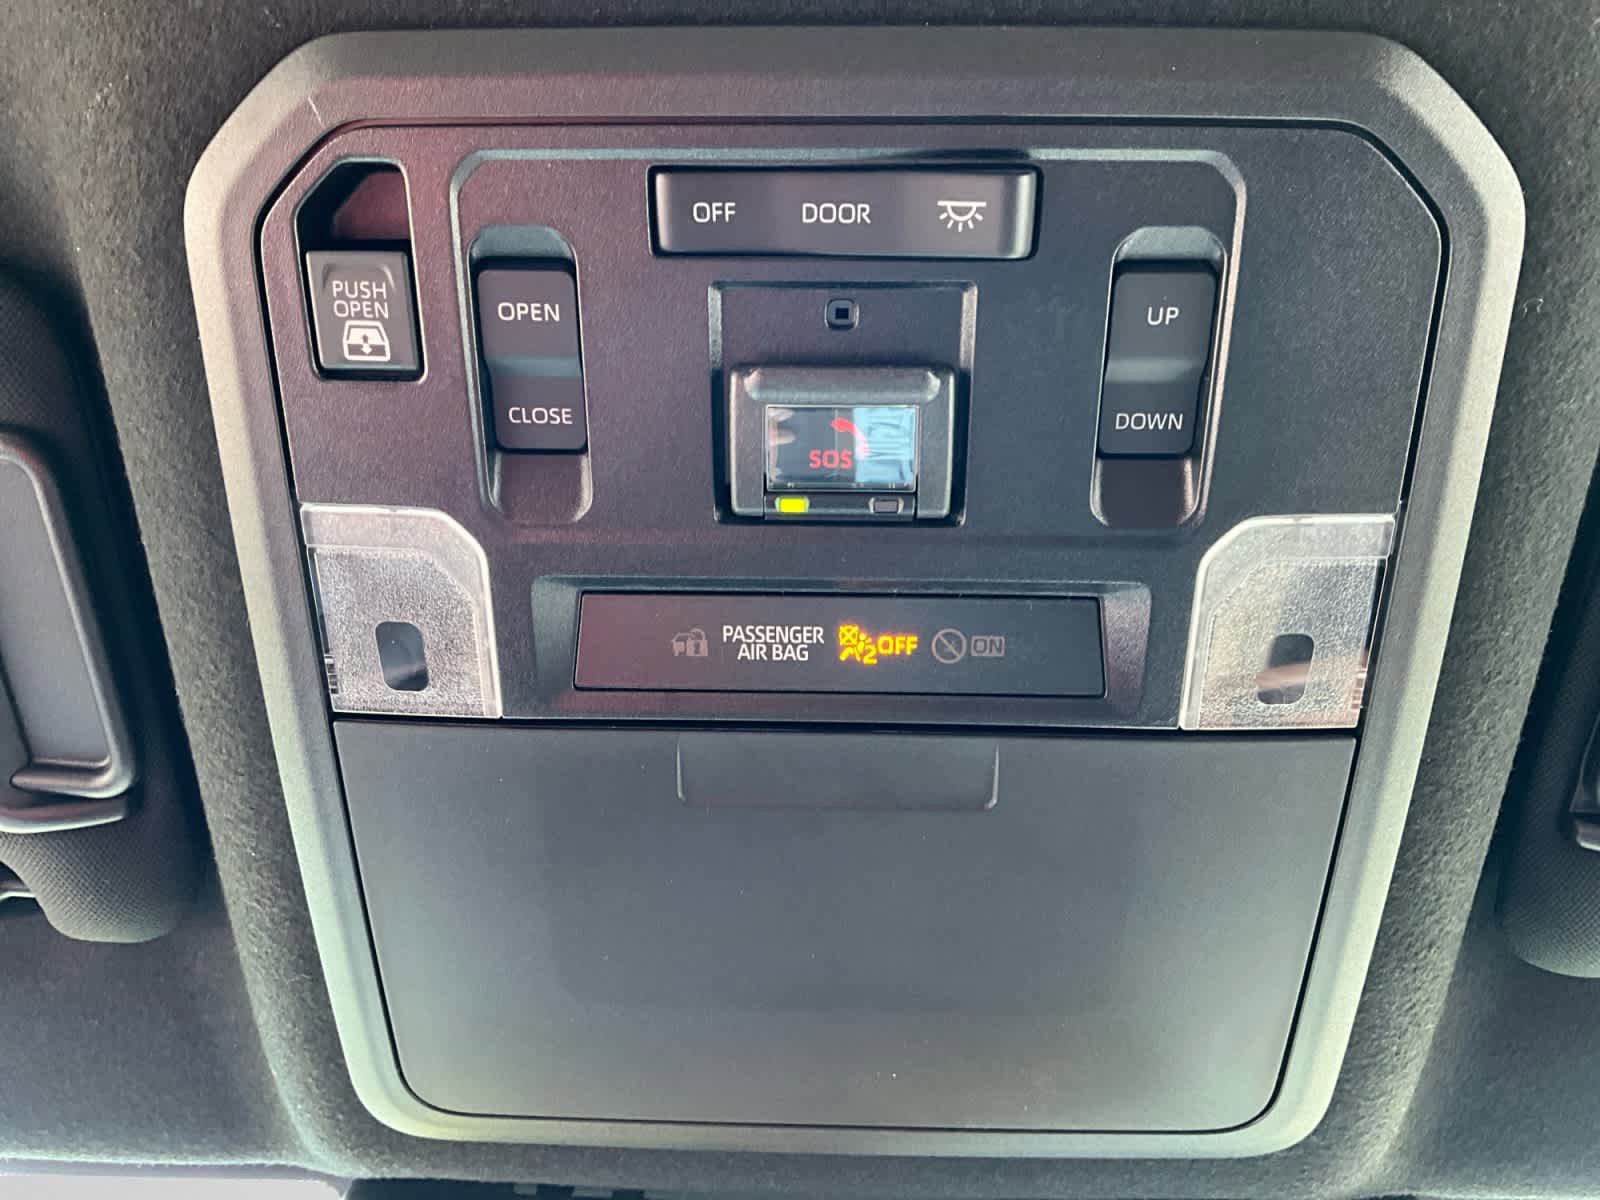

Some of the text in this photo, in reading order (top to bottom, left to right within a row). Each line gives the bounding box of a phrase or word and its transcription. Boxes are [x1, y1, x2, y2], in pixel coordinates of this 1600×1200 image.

[692, 202, 736, 223] OFF
[801, 202, 871, 224] DOOR
[332, 280, 388, 299] PUSH
[333, 300, 389, 319] OPEN
[497, 301, 561, 322] OPEN
[1146, 306, 1179, 326] UP
[508, 407, 573, 425] CLOSE
[1115, 412, 1184, 431] DOWN
[808, 449, 853, 470] SOS
[722, 625, 825, 646] PASSENGER
[878, 635, 918, 655] OFF
[737, 644, 810, 662] AIR BAG
[975, 637, 1003, 656] ON
